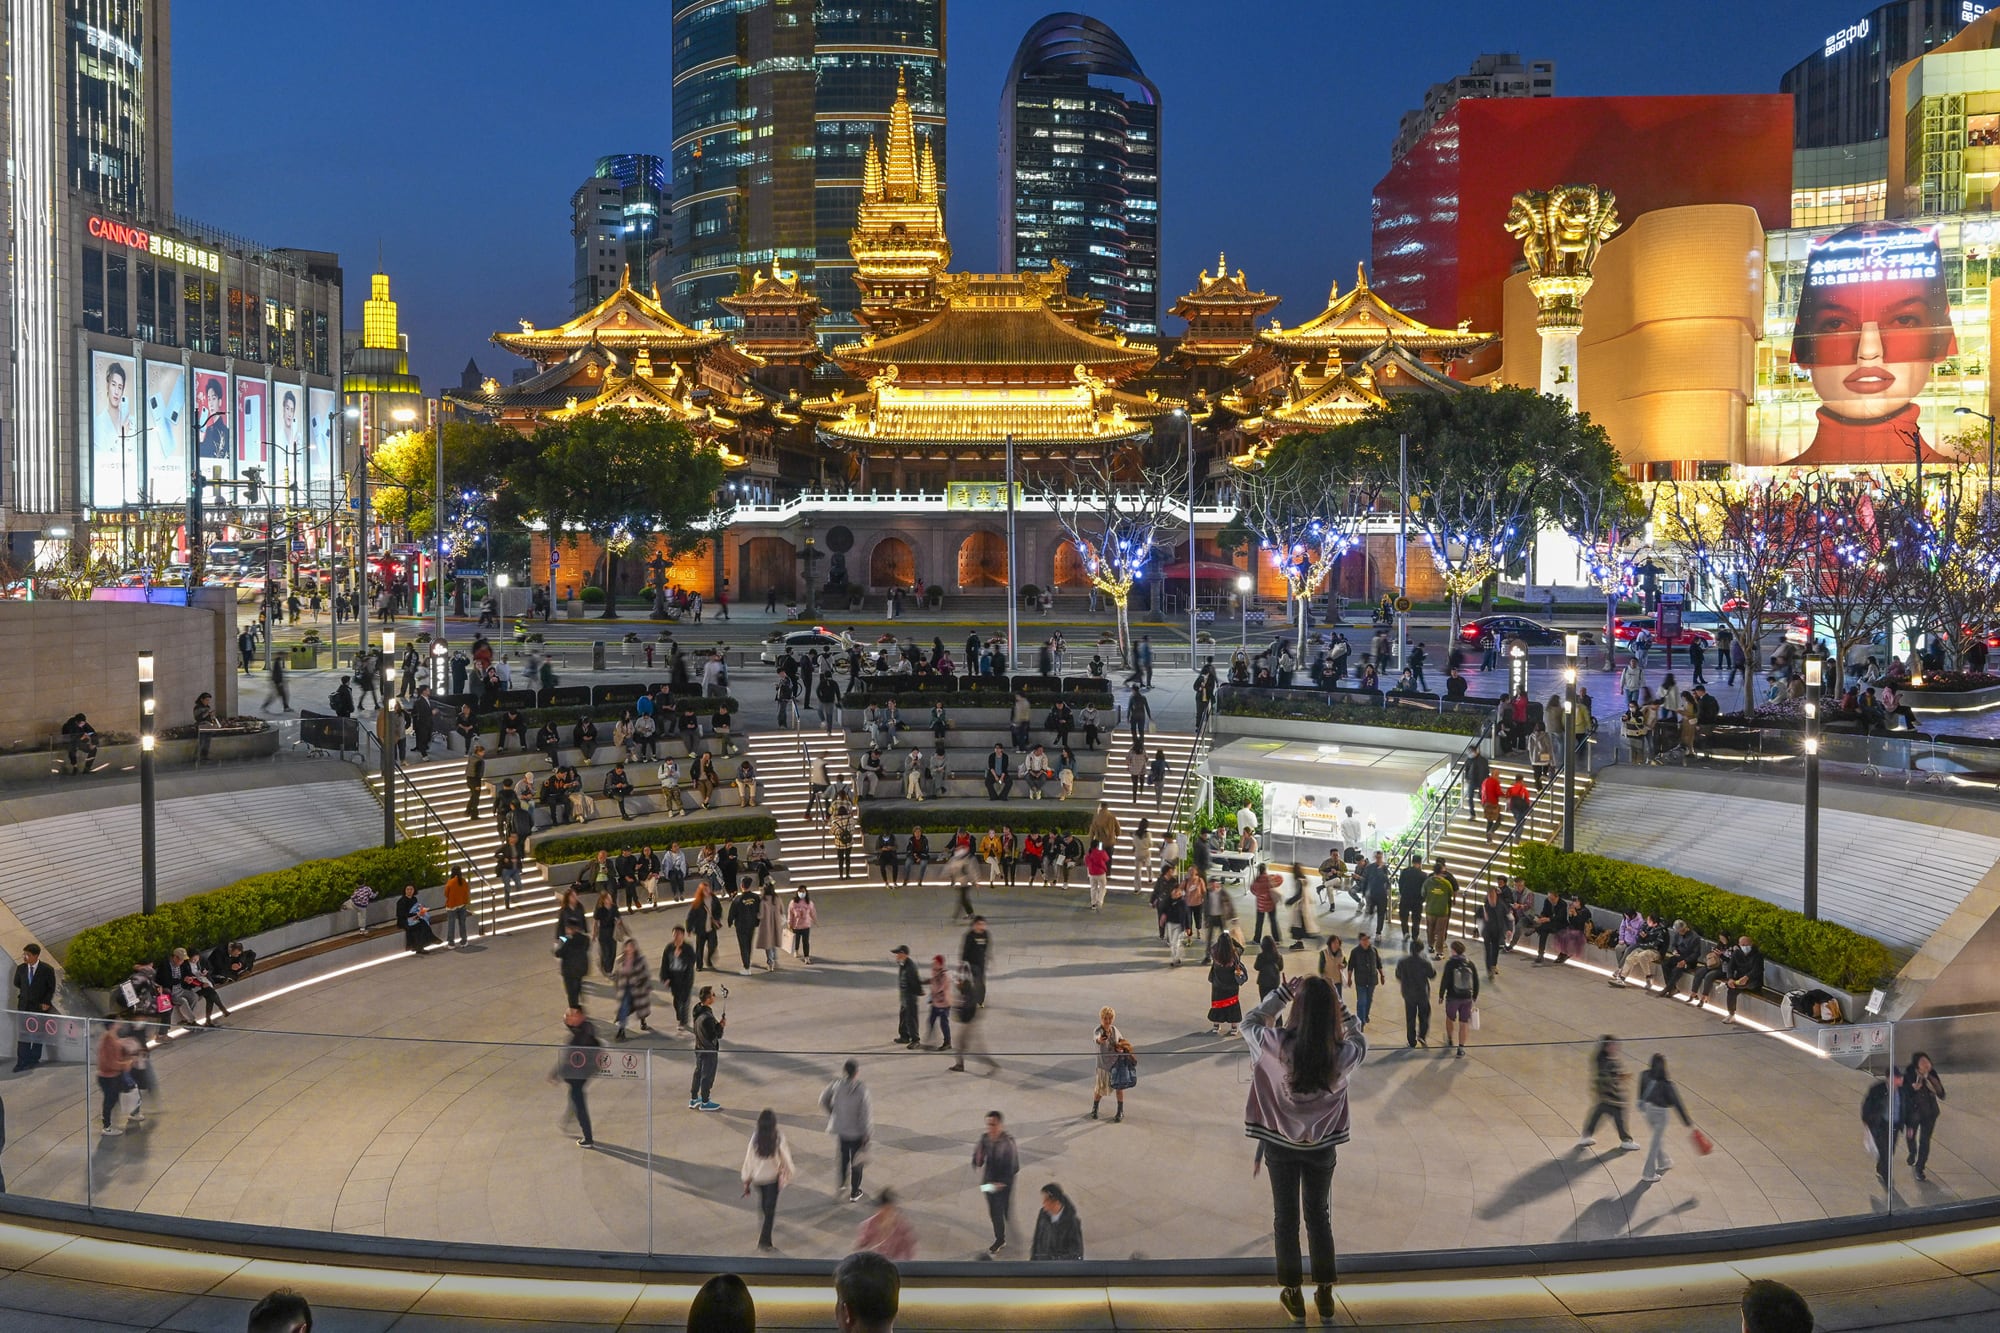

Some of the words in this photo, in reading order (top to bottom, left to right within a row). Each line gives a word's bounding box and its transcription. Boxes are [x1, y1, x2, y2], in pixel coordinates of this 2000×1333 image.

[1825, 19, 1869, 57] 晶品中心
[89, 216, 148, 251] CANNOR
[149, 234, 219, 273] 凯纳咨询集团
